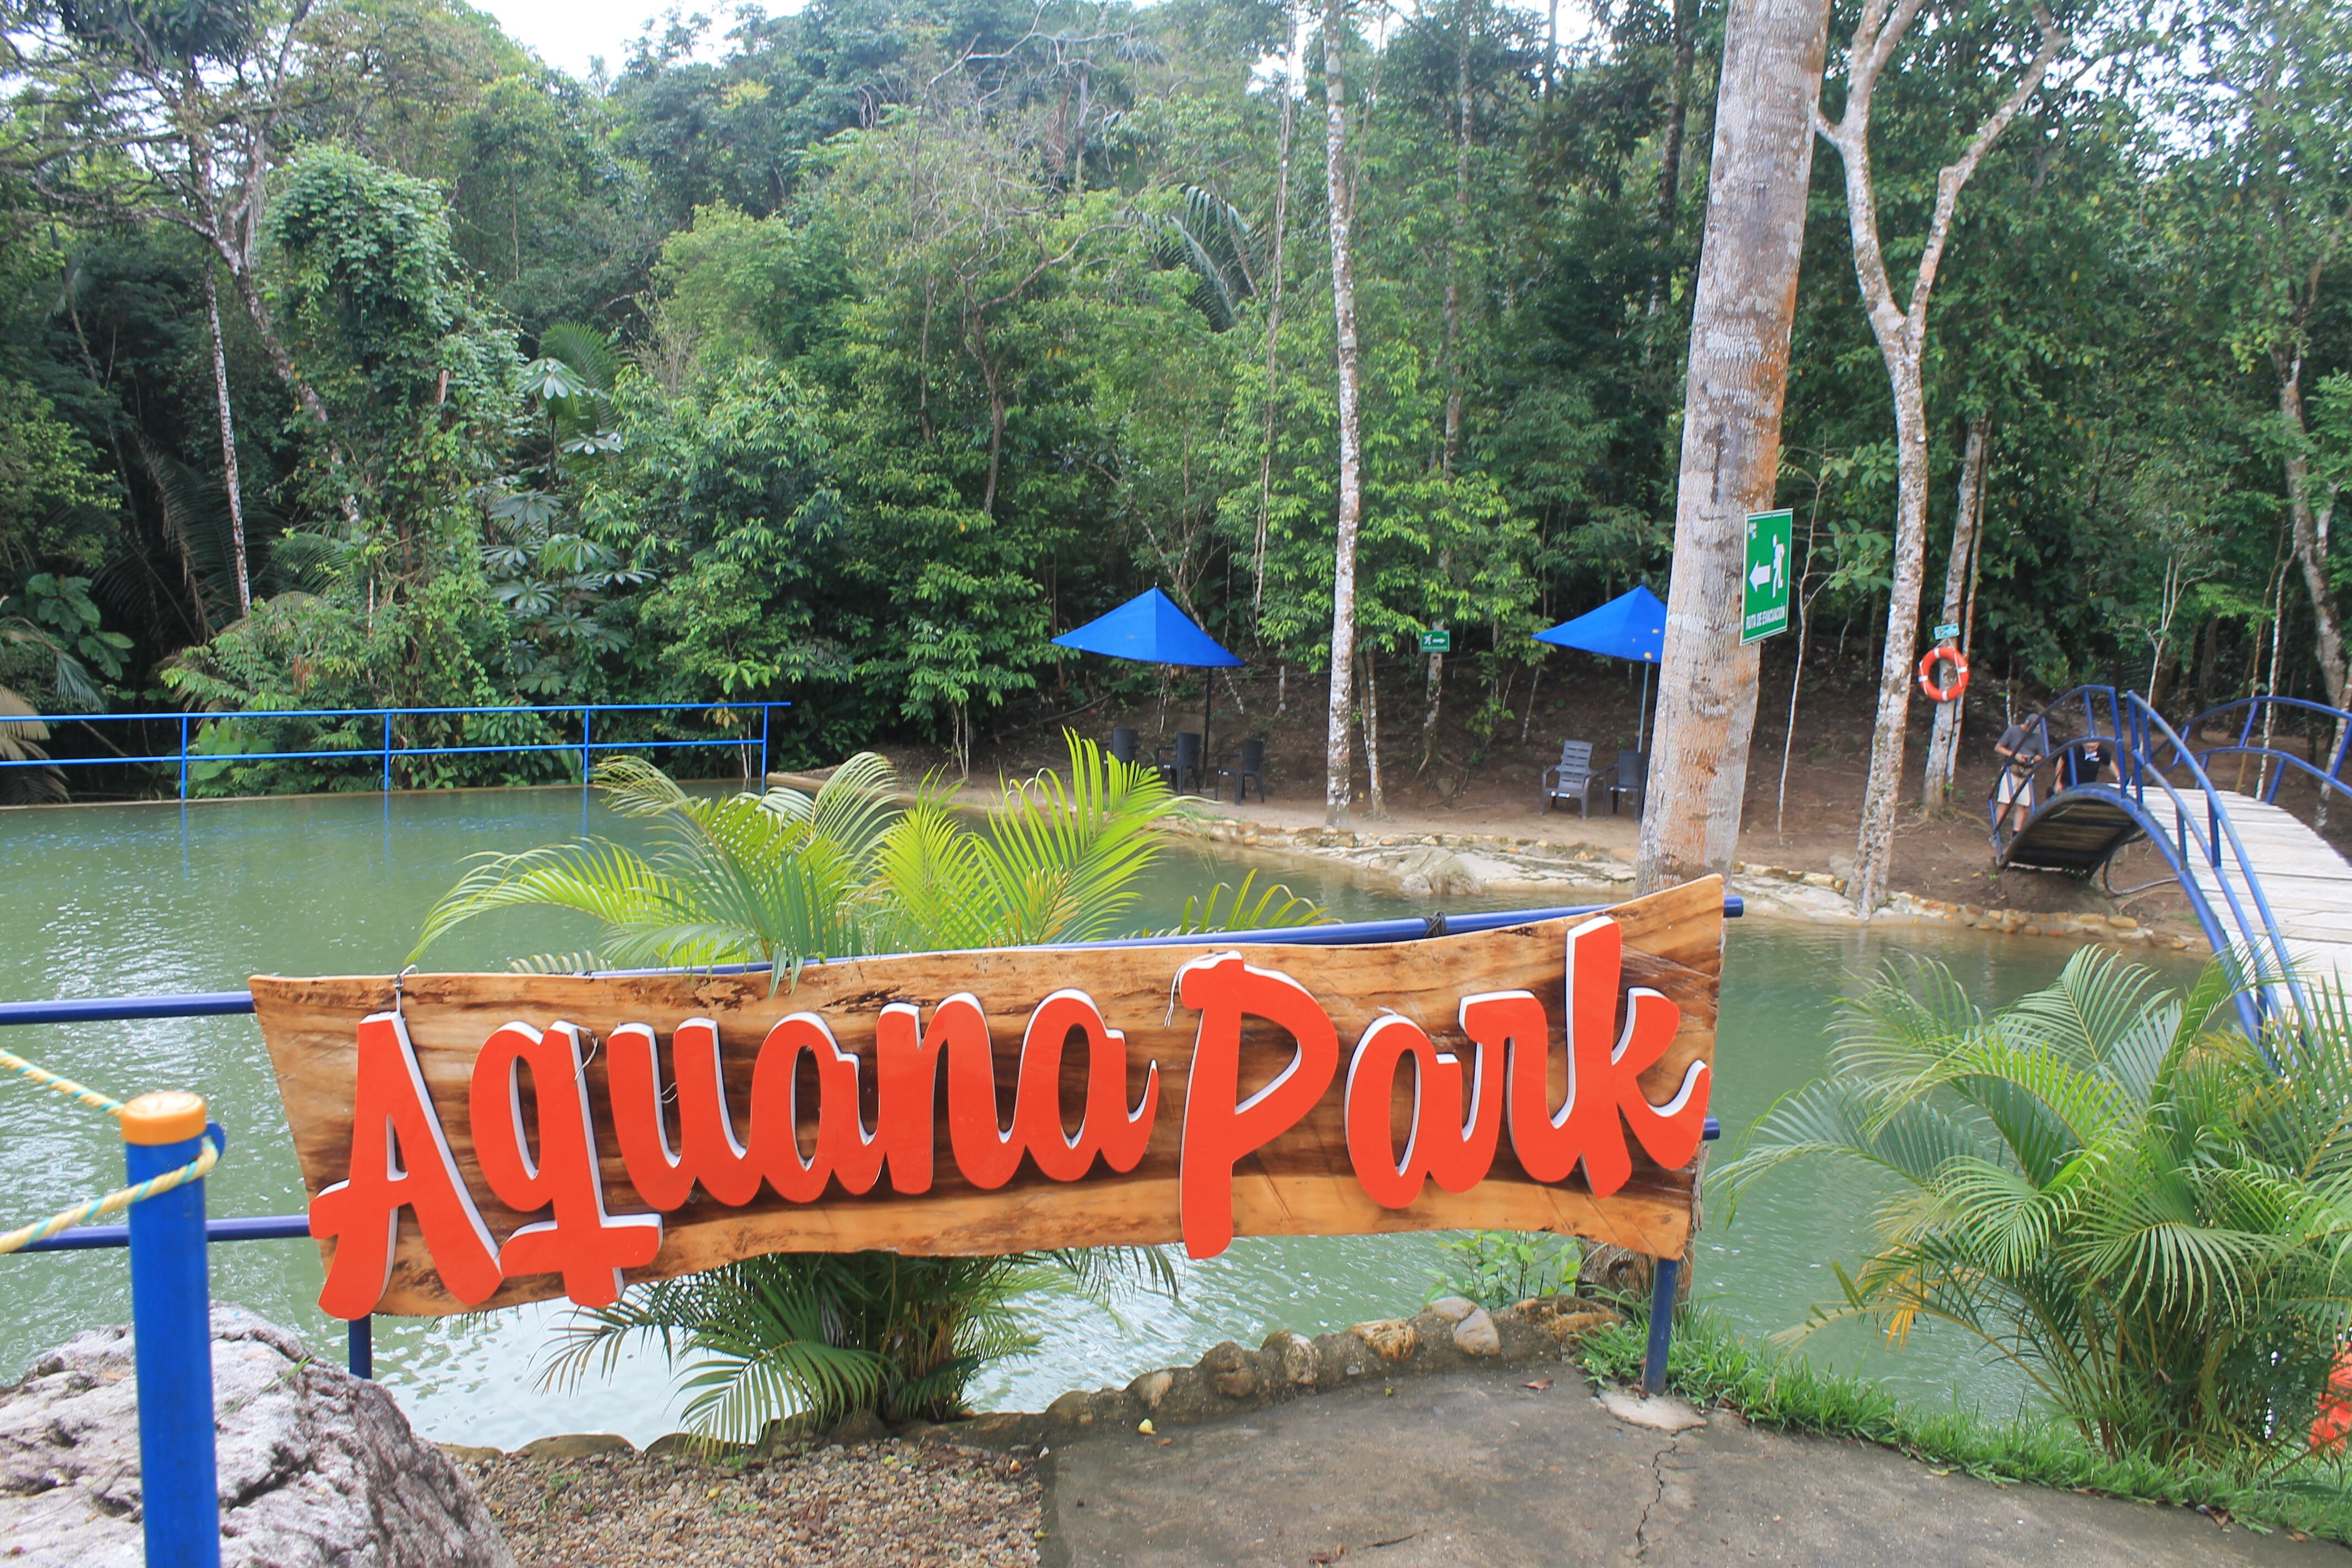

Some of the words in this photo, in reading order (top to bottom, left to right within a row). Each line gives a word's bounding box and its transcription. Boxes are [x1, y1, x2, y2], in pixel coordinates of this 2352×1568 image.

[1757, 612, 1762, 628] DE
[309, 988, 1159, 1320] Aquana
[1179, 916, 1711, 1260] Park
